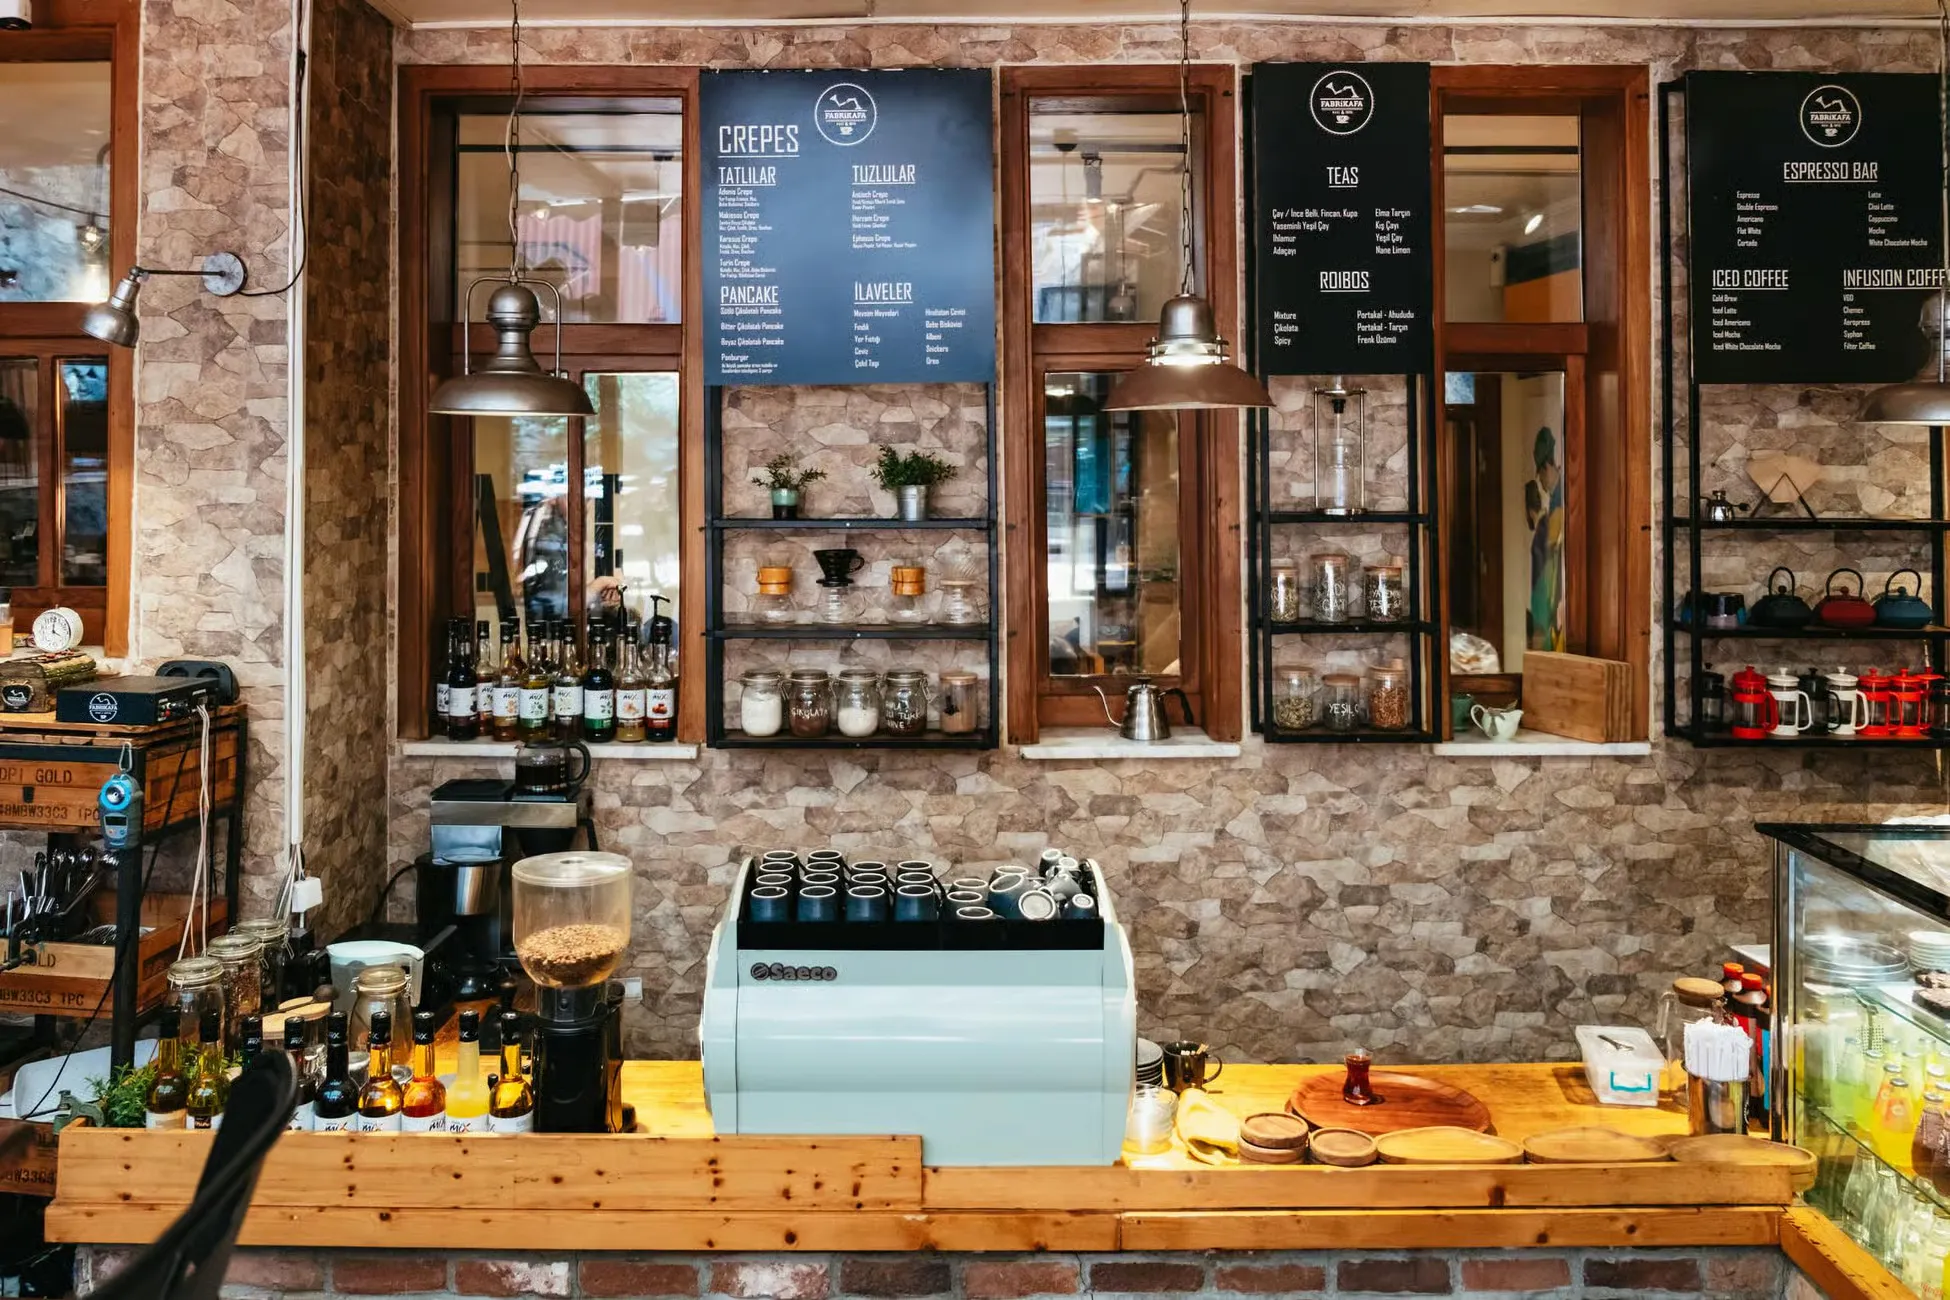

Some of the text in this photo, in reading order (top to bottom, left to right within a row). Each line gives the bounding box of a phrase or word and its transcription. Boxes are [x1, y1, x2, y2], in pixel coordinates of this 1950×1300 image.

[719, 125, 799, 153] CREPES
[719, 167, 776, 184] TATLILAR
[852, 165, 915, 182] TUZLULAR
[1326, 167, 1359, 185] TEAS
[1784, 162, 1878, 179] ESPRESSO BAR
[1272, 209, 1284, 219] Çay
[1342, 209, 1358, 219] Kupa
[1375, 208, 1390, 217] Elma
[1317, 221, 1329, 231] Çay
[1391, 233, 1403, 243] Çay
[1376, 246, 1411, 254] Nane Limon
[1320, 271, 1369, 289] ROIBOS
[1712, 270, 1789, 287] ICED COFFEE
[1843, 269, 1902, 287] INFUSION
[721, 286, 778, 303] PANCAKE
[854, 281, 912, 301] İLAVELER
[1274, 311, 1296, 319] Mixture
[1357, 310, 1383, 319] Portakal
[1388, 310, 1414, 319] Ahududu
[1357, 322, 1383, 331] Portakal
[1274, 336, 1291, 346] Spicy
[1357, 335, 1375, 344] Frenk
[35, 768, 72, 784] GOLD
[769, 962, 838, 981] Saeco
